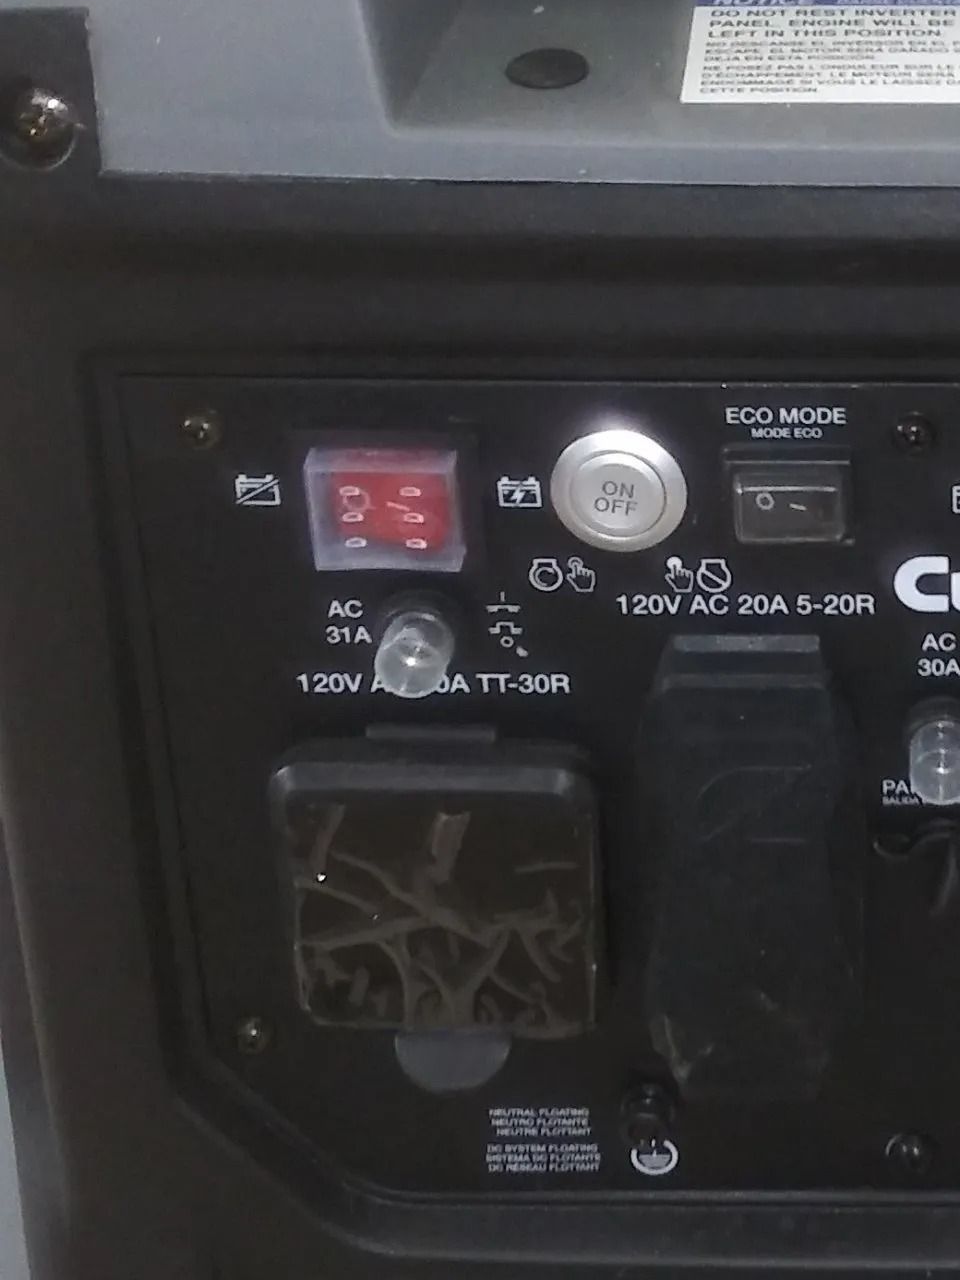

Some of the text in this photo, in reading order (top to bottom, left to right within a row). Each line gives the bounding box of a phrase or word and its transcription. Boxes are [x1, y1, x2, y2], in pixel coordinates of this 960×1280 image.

[711, 9, 740, 17] DO
[746, 9, 787, 17] NOT
[795, 9, 846, 17] REST
[855, 9, 957, 17] INVERTER
[788, 19, 865, 27] ENGINE
[873, 19, 920, 27] WILL
[928, 19, 955, 27] BE
[707, 29, 758, 38] LEFT
[765, 29, 784, 37] IN
[793, 29, 837, 37] THIS
[725, 407, 847, 425] ECO MODE
[751, 427, 823, 439] MODE ECO
[601, 480, 635, 498] ON
[594, 496, 638, 517] OFF
[327, 599, 364, 618] AC
[616, 594, 876, 616] 120V AC 20A 5-20R
[325, 625, 373, 644] 31A
[921, 632, 957, 651] AC
[296, 673, 363, 693] 120V
[475, 673, 571, 694] TT-30R
